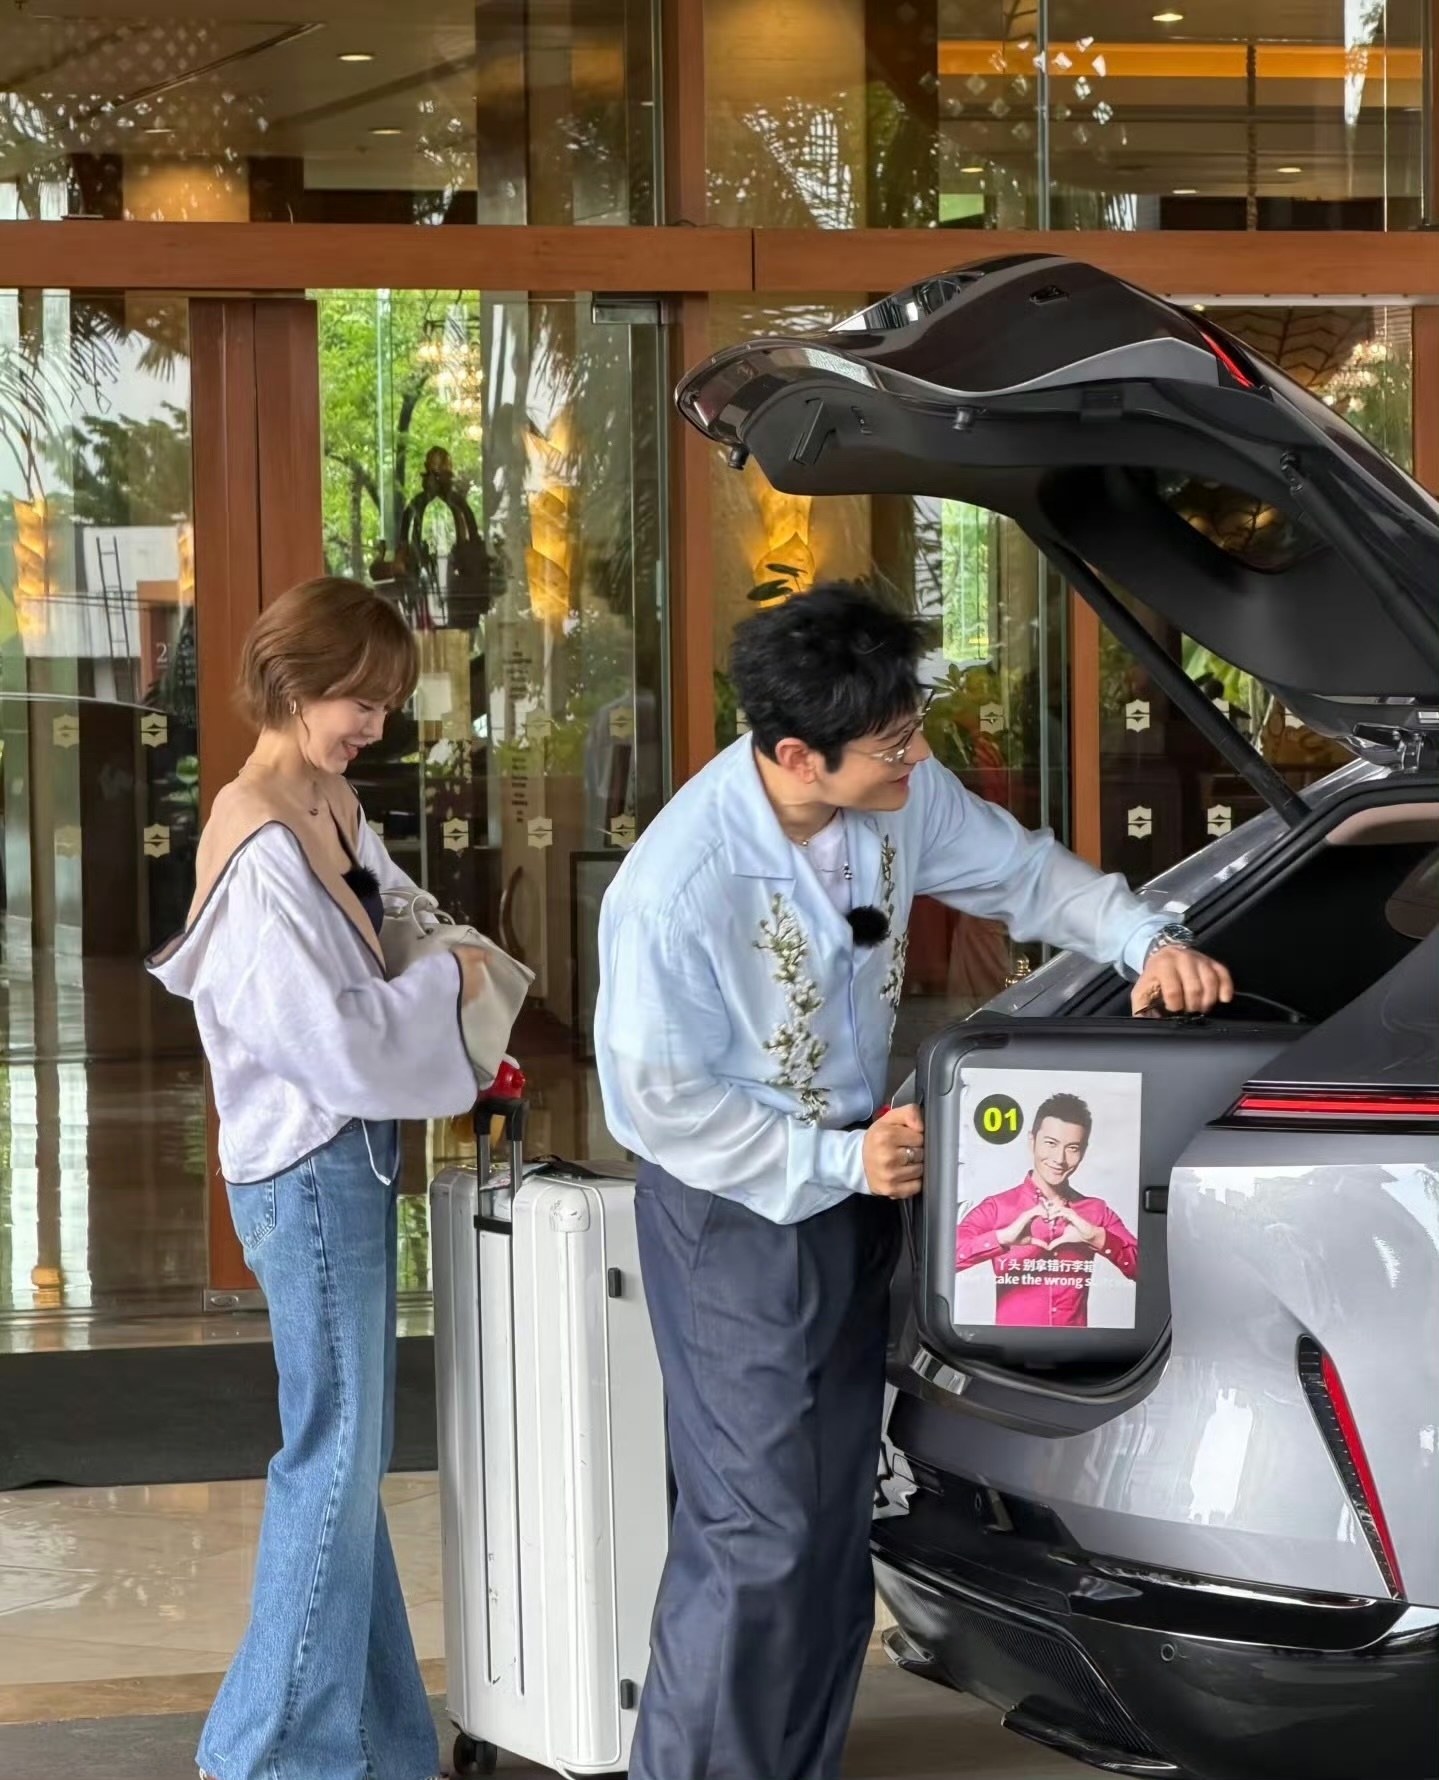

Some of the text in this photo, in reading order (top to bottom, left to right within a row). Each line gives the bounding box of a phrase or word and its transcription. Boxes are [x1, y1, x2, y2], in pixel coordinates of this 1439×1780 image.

[983, 1107, 1018, 1132] 01
[997, 1259, 1021, 1271] 丫头
[1021, 1273, 1042, 1286] the
[1044, 1276, 1083, 1289] wrong
